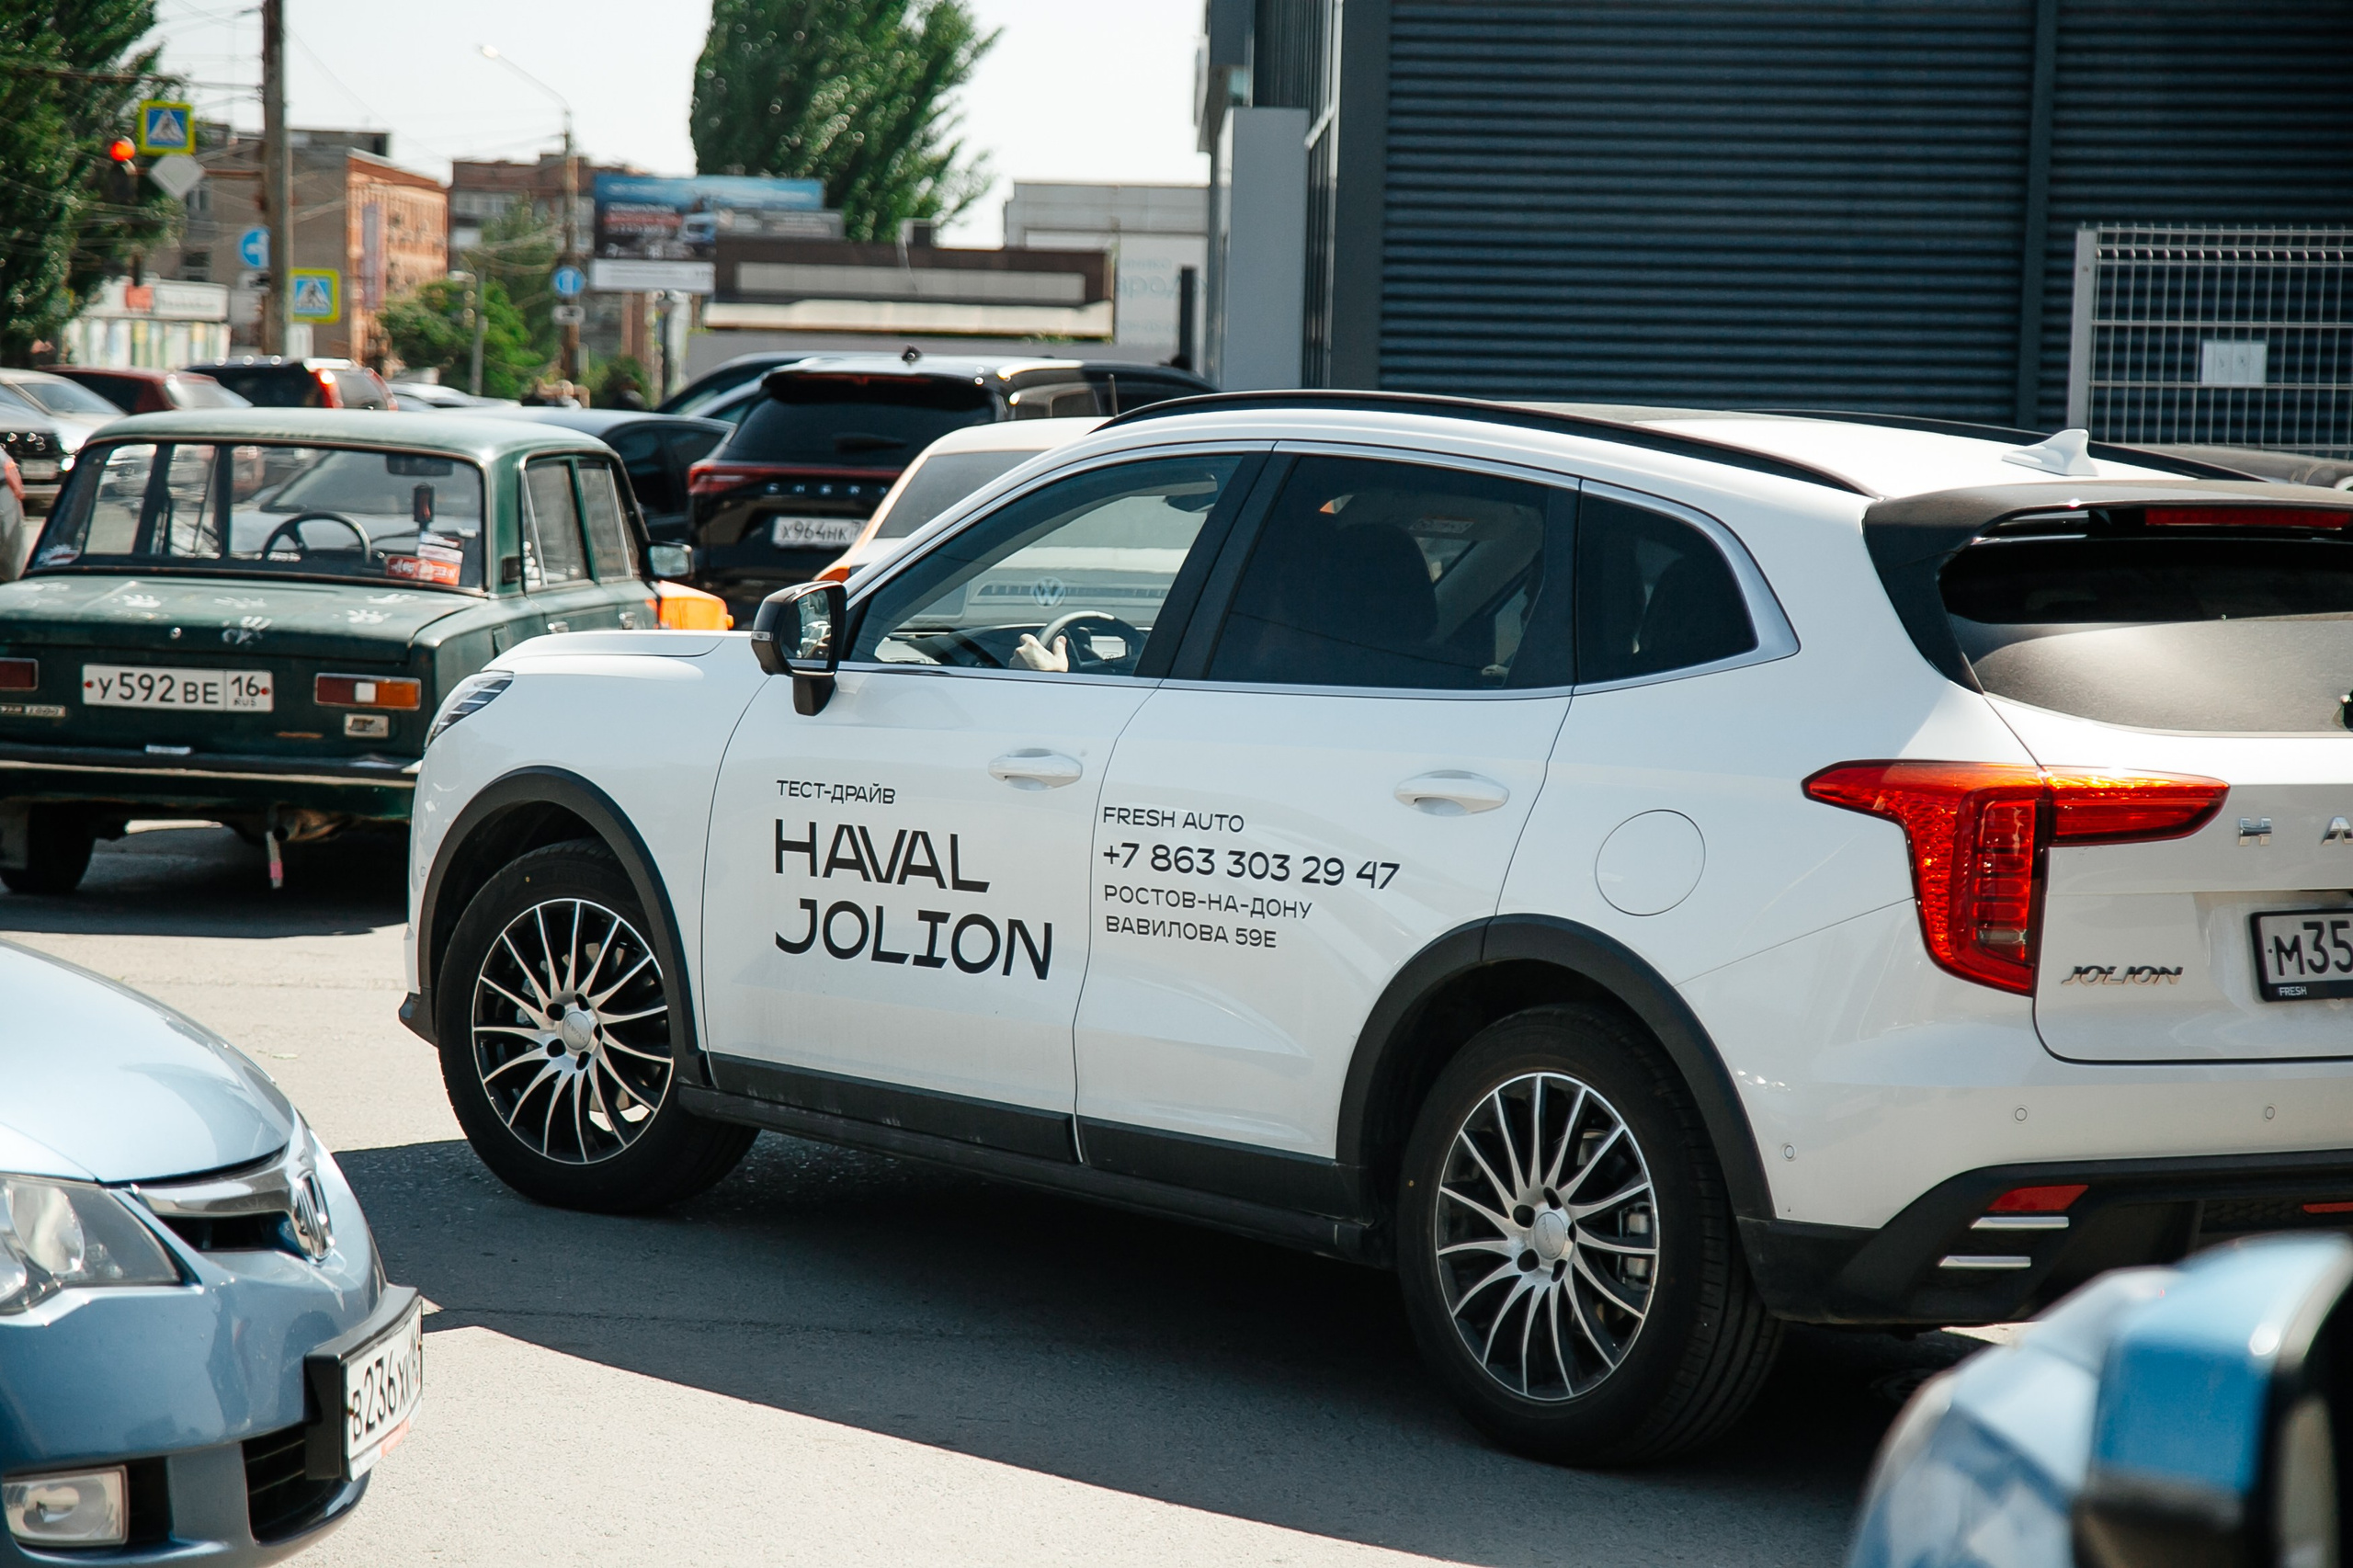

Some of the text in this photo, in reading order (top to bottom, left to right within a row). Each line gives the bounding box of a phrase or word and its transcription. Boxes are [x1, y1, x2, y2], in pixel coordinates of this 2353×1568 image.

[98, 672, 261, 705] У592ВЕ 16
[233, 698, 257, 707] RUS
[776, 779, 896, 804] ТЕСТ-ДРАЙВ
[1103, 806, 1245, 833] FRESH AUTO
[775, 818, 991, 893] HAVAL
[1103, 842, 1400, 890] +7 863 303 29 47
[1104, 884, 1313, 919] РОСТОВ-НА-ДОНУ
[775, 897, 1052, 981] JOLION
[1106, 915, 1277, 949] ВАВИЛОВА 59Е
[2061, 966, 2184, 987] JOLION
[2279, 986, 2308, 997] FRESH
